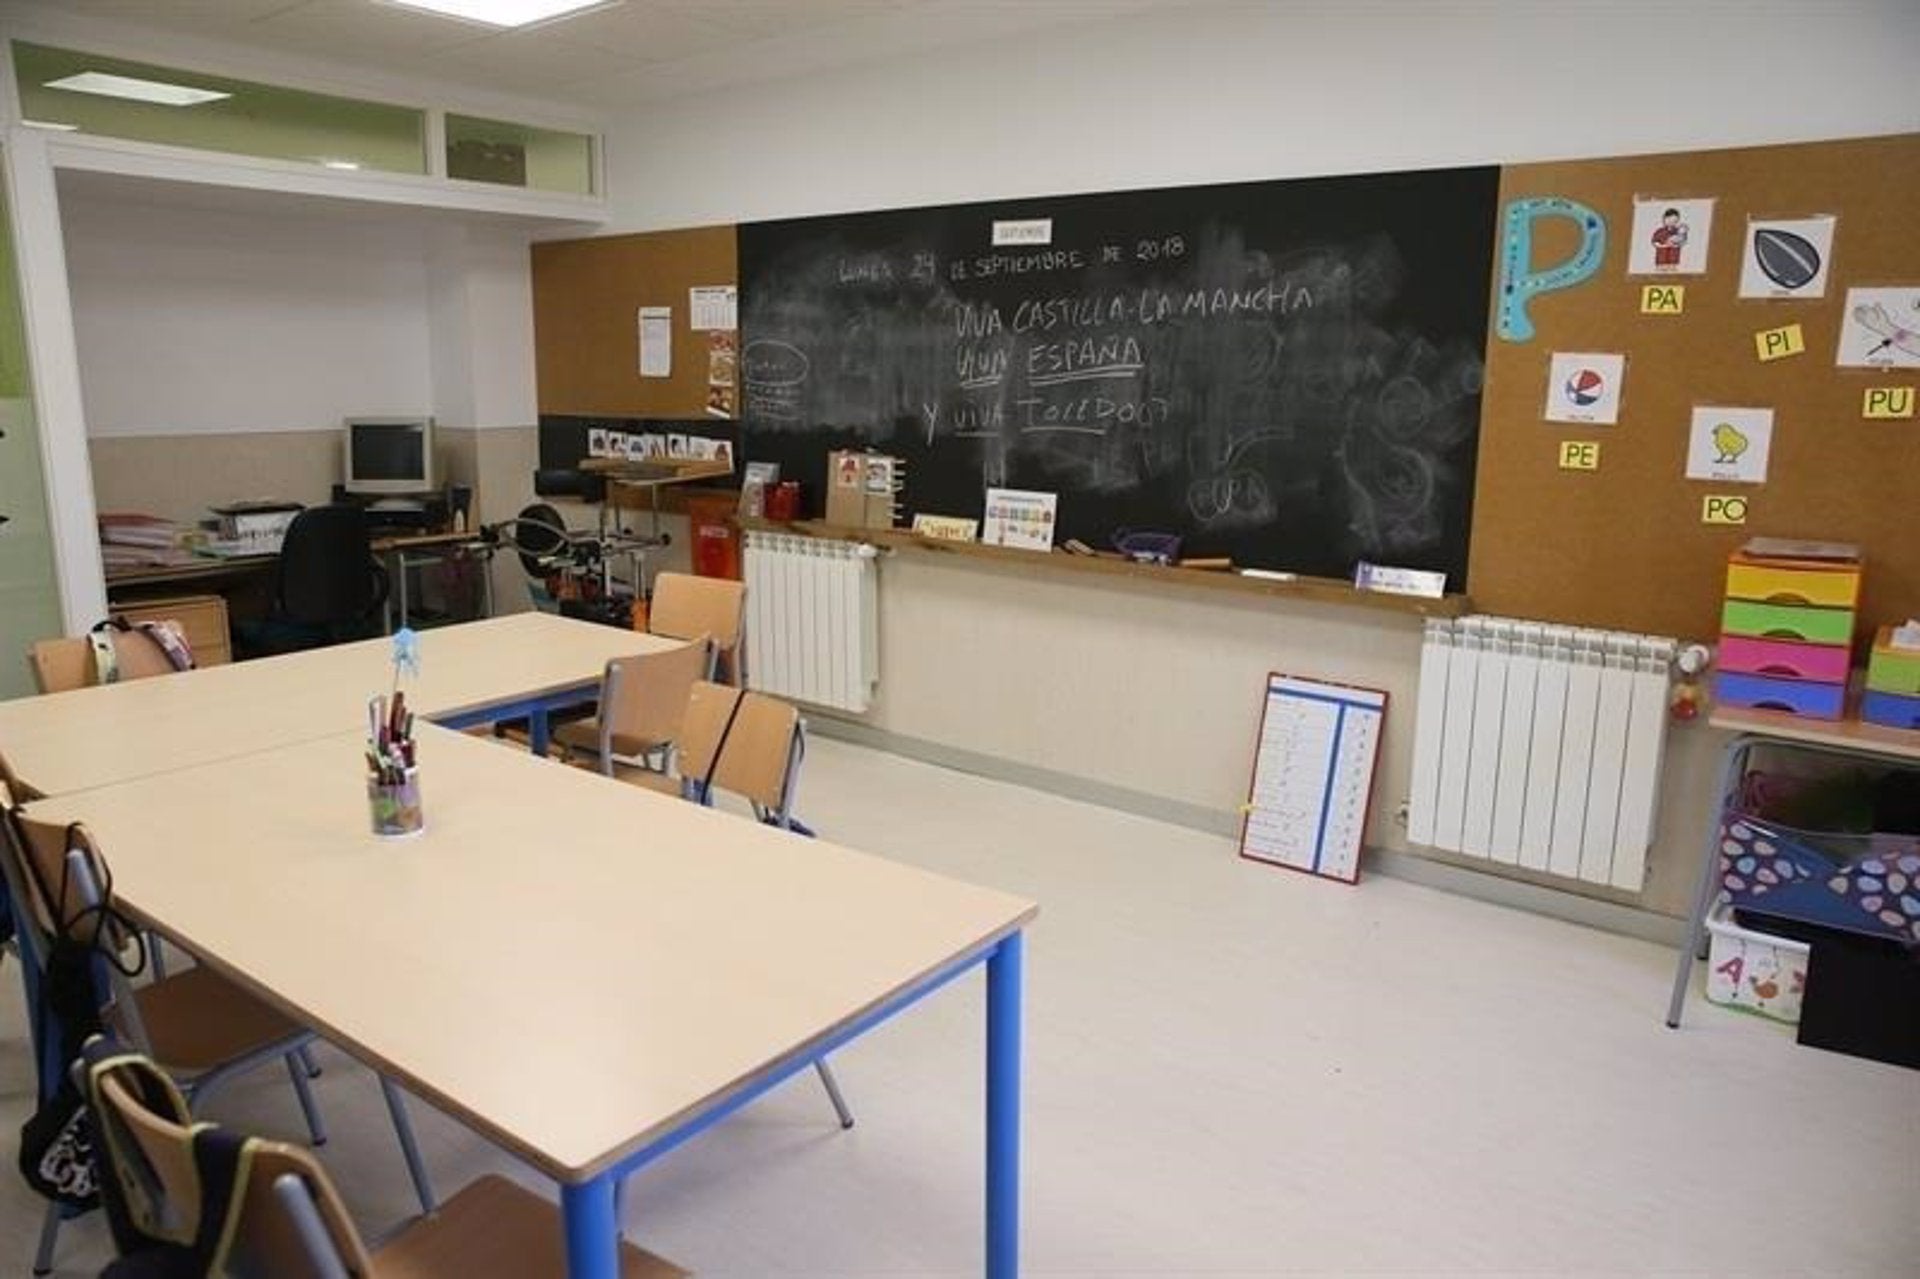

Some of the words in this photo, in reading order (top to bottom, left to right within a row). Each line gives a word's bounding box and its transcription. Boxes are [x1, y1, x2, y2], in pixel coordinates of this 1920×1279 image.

[974, 249, 1085, 277] SEPTIEMBRE
[1137, 235, 1185, 261] 2018
[1495, 198, 1607, 343] P
[955, 305, 1002, 337] VIVA
[1182, 280, 1313, 317] MANCHA
[1646, 288, 1680, 311] PA
[1028, 335, 1142, 374] ESPAÑA
[1766, 331, 1790, 356] PI
[1869, 390, 1908, 413] PU
[1566, 444, 1595, 466] PE
[1706, 499, 1748, 521] PO
